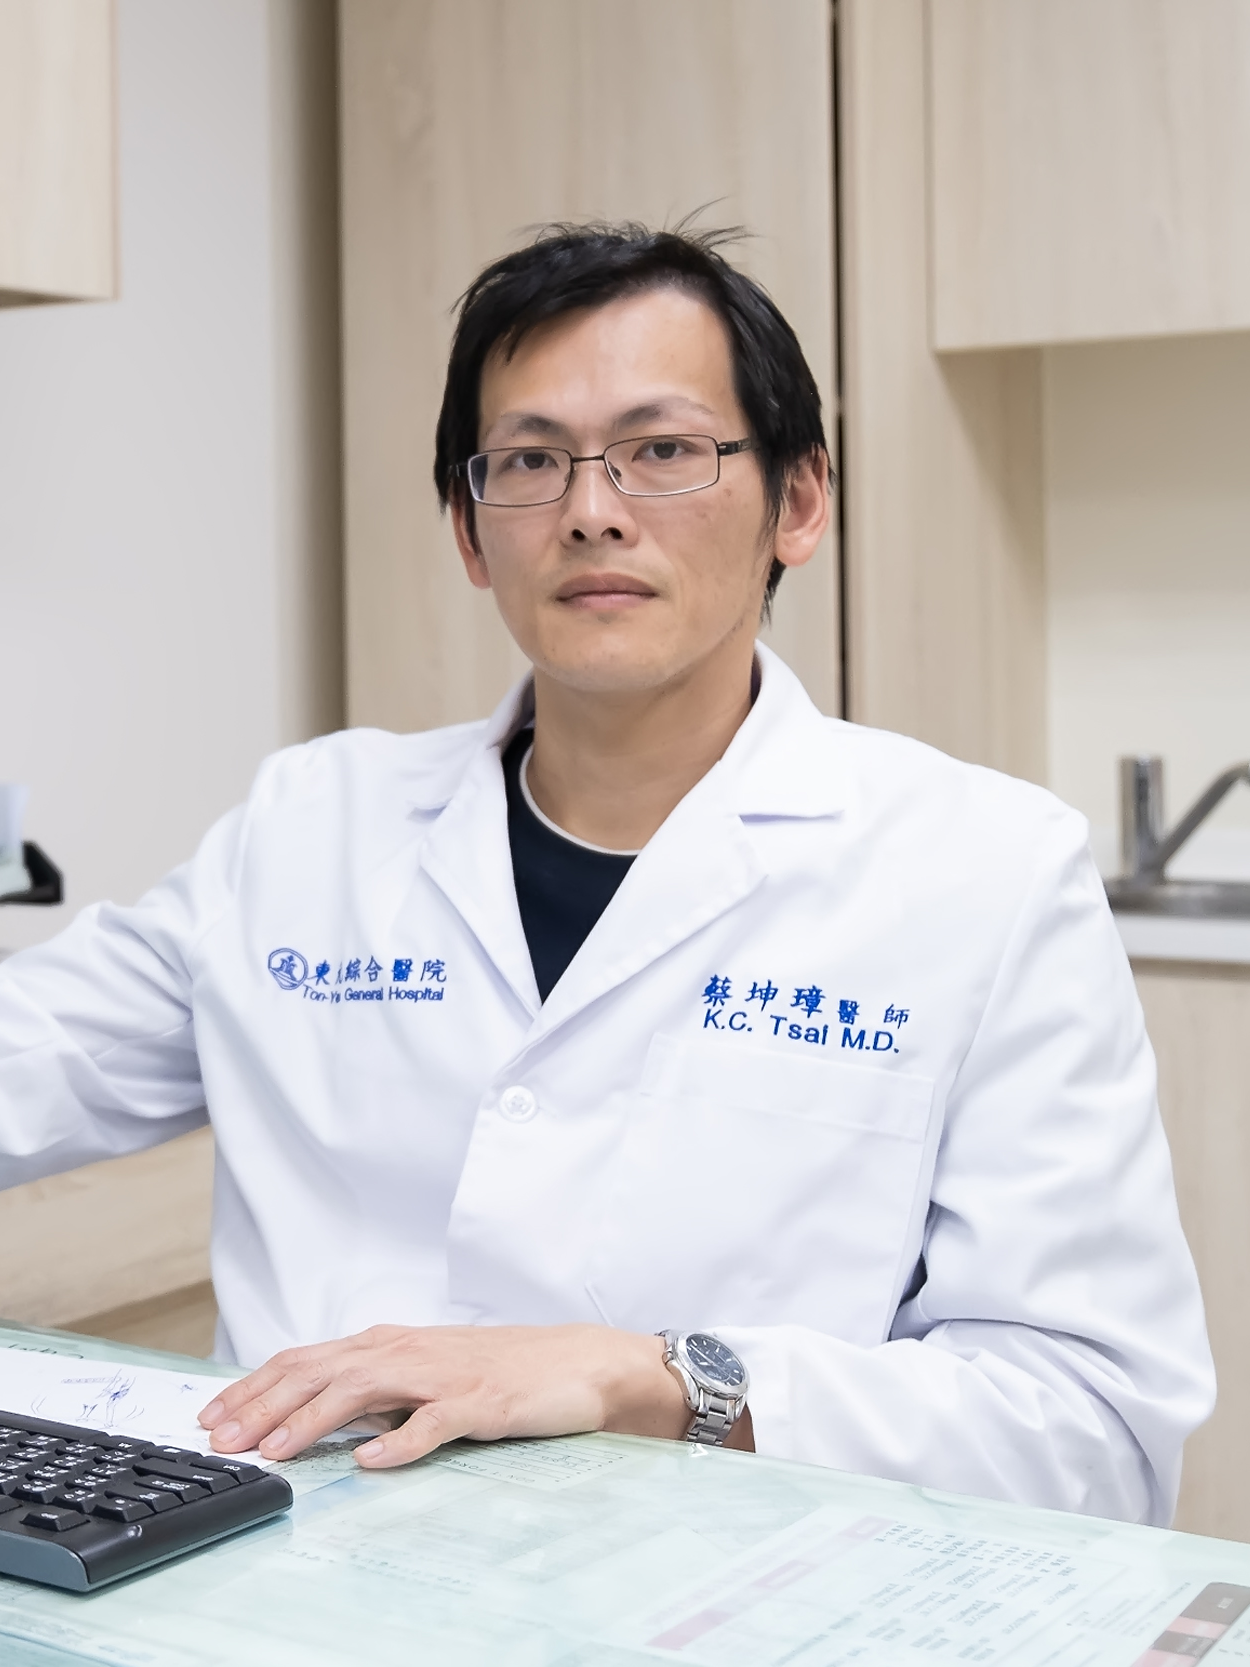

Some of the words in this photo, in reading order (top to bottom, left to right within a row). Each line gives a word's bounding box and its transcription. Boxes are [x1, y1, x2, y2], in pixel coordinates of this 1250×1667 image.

[344, 987, 384, 1002] General
[388, 986, 445, 1004] Hospital
[701, 974, 911, 1030] 蔡坤璋醫師
[703, 1008, 753, 1032] K.C.
[769, 1015, 829, 1046] Tsai
[841, 1027, 900, 1054] M.D.
